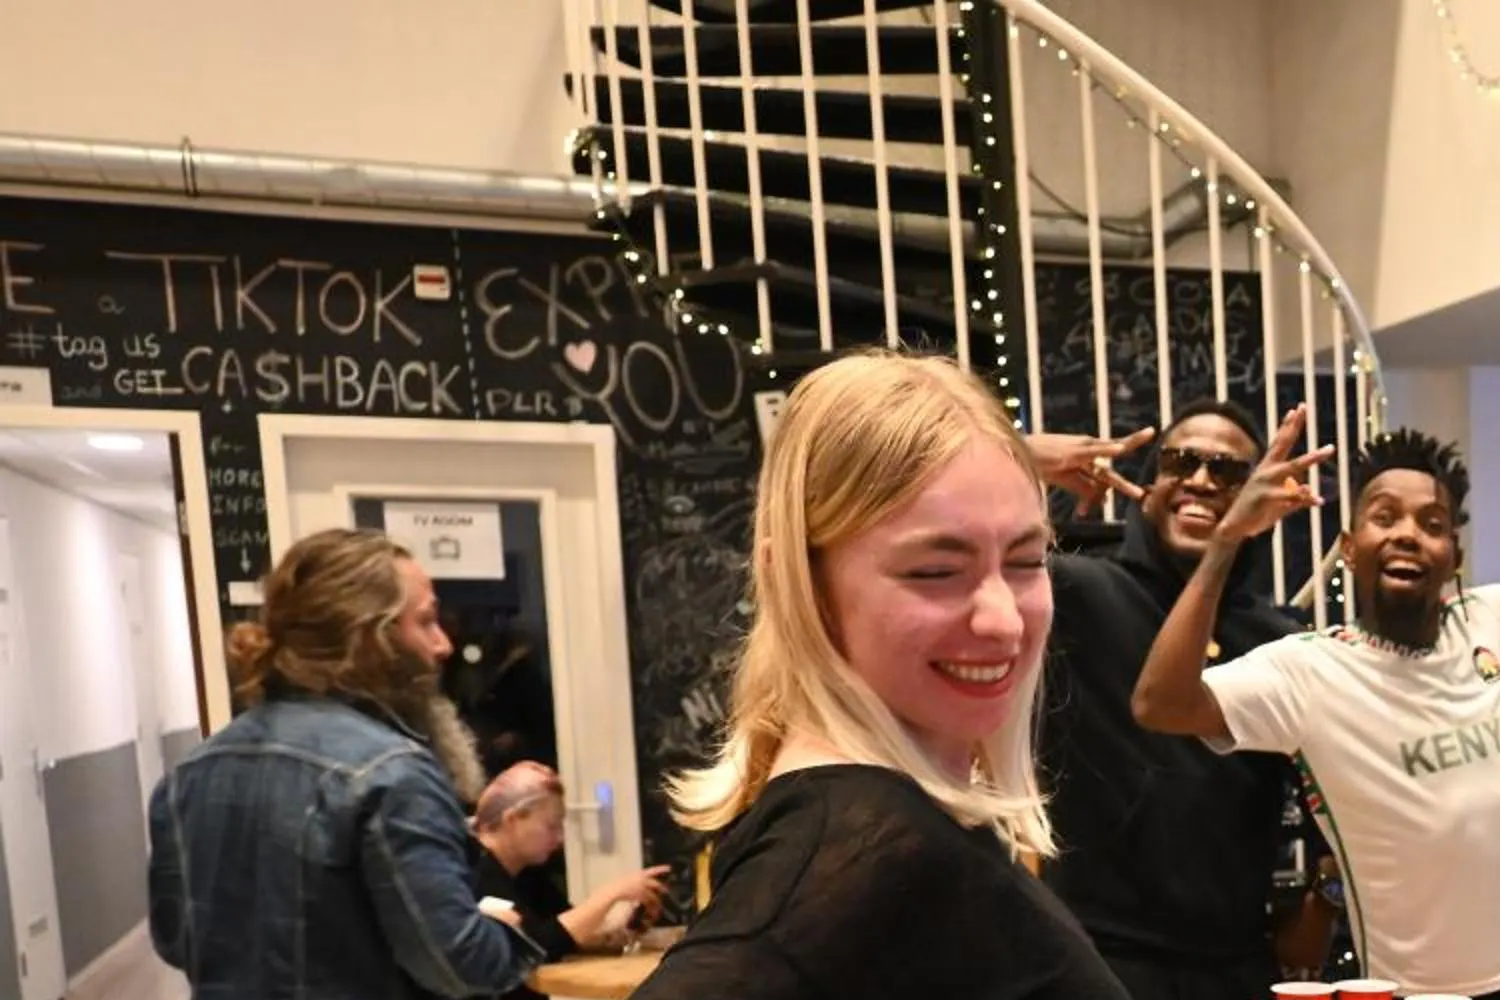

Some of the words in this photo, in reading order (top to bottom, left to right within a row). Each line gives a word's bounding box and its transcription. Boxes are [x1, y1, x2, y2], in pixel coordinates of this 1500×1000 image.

[98, 295, 126, 314] a
[105, 251, 423, 347] TIKTOK
[123, 332, 160, 358] us
[113, 369, 167, 395] GET
[553, 330, 742, 447] YOU
[209, 467, 262, 488] MORE
[212, 495, 266, 515] INFO
